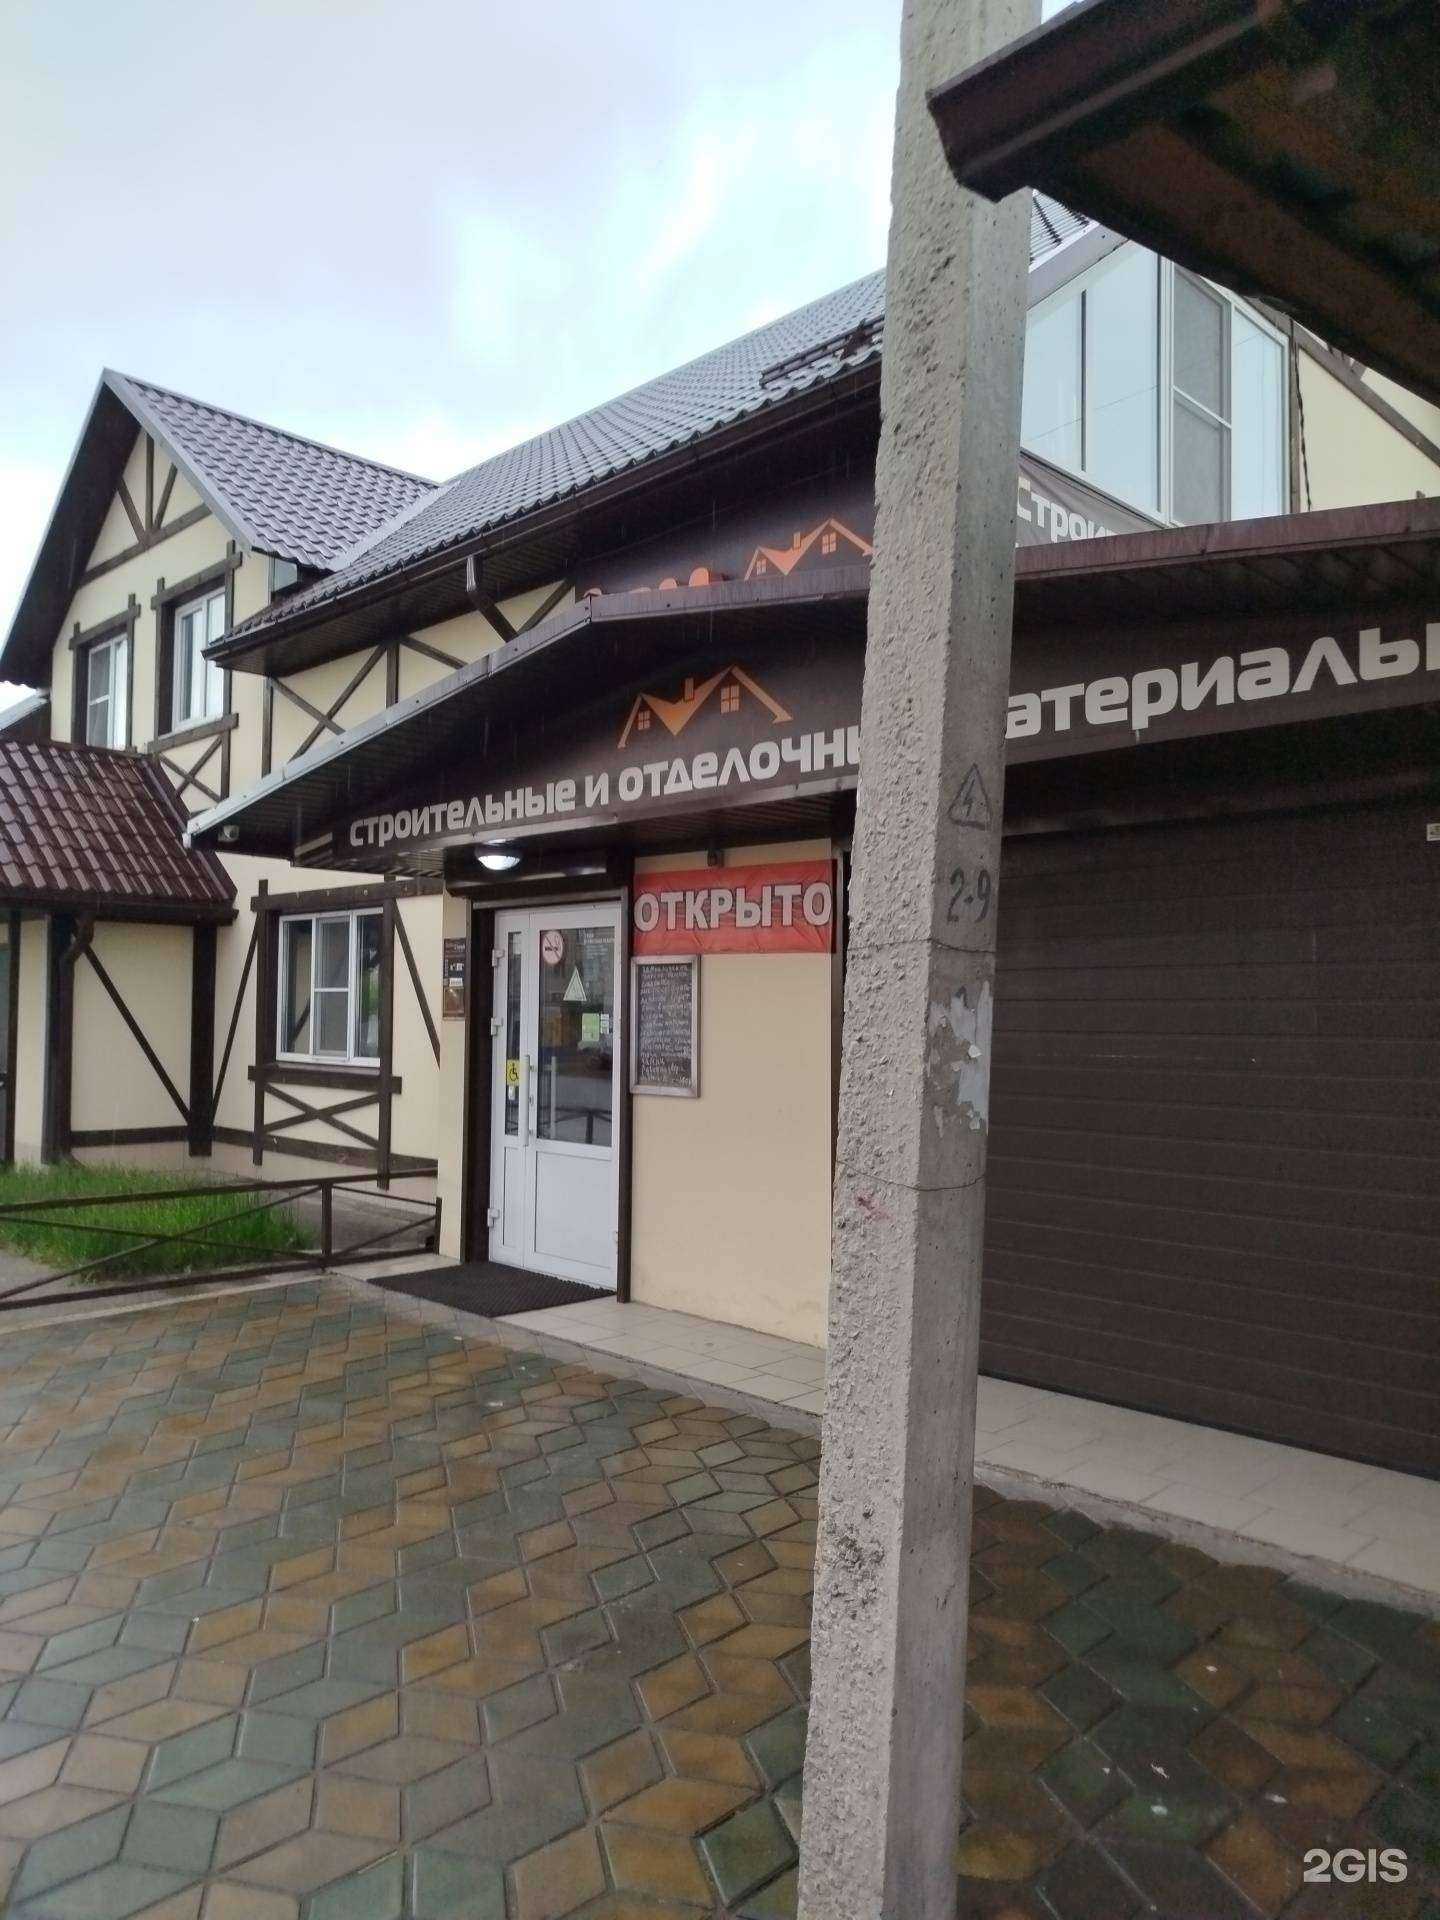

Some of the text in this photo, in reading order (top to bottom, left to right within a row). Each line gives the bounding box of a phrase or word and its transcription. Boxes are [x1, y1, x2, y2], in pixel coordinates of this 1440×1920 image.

[618, 725, 861, 803] отделочн
[1005, 622, 1440, 741] атериалы
[634, 881, 832, 932] ОТКРЫТО
